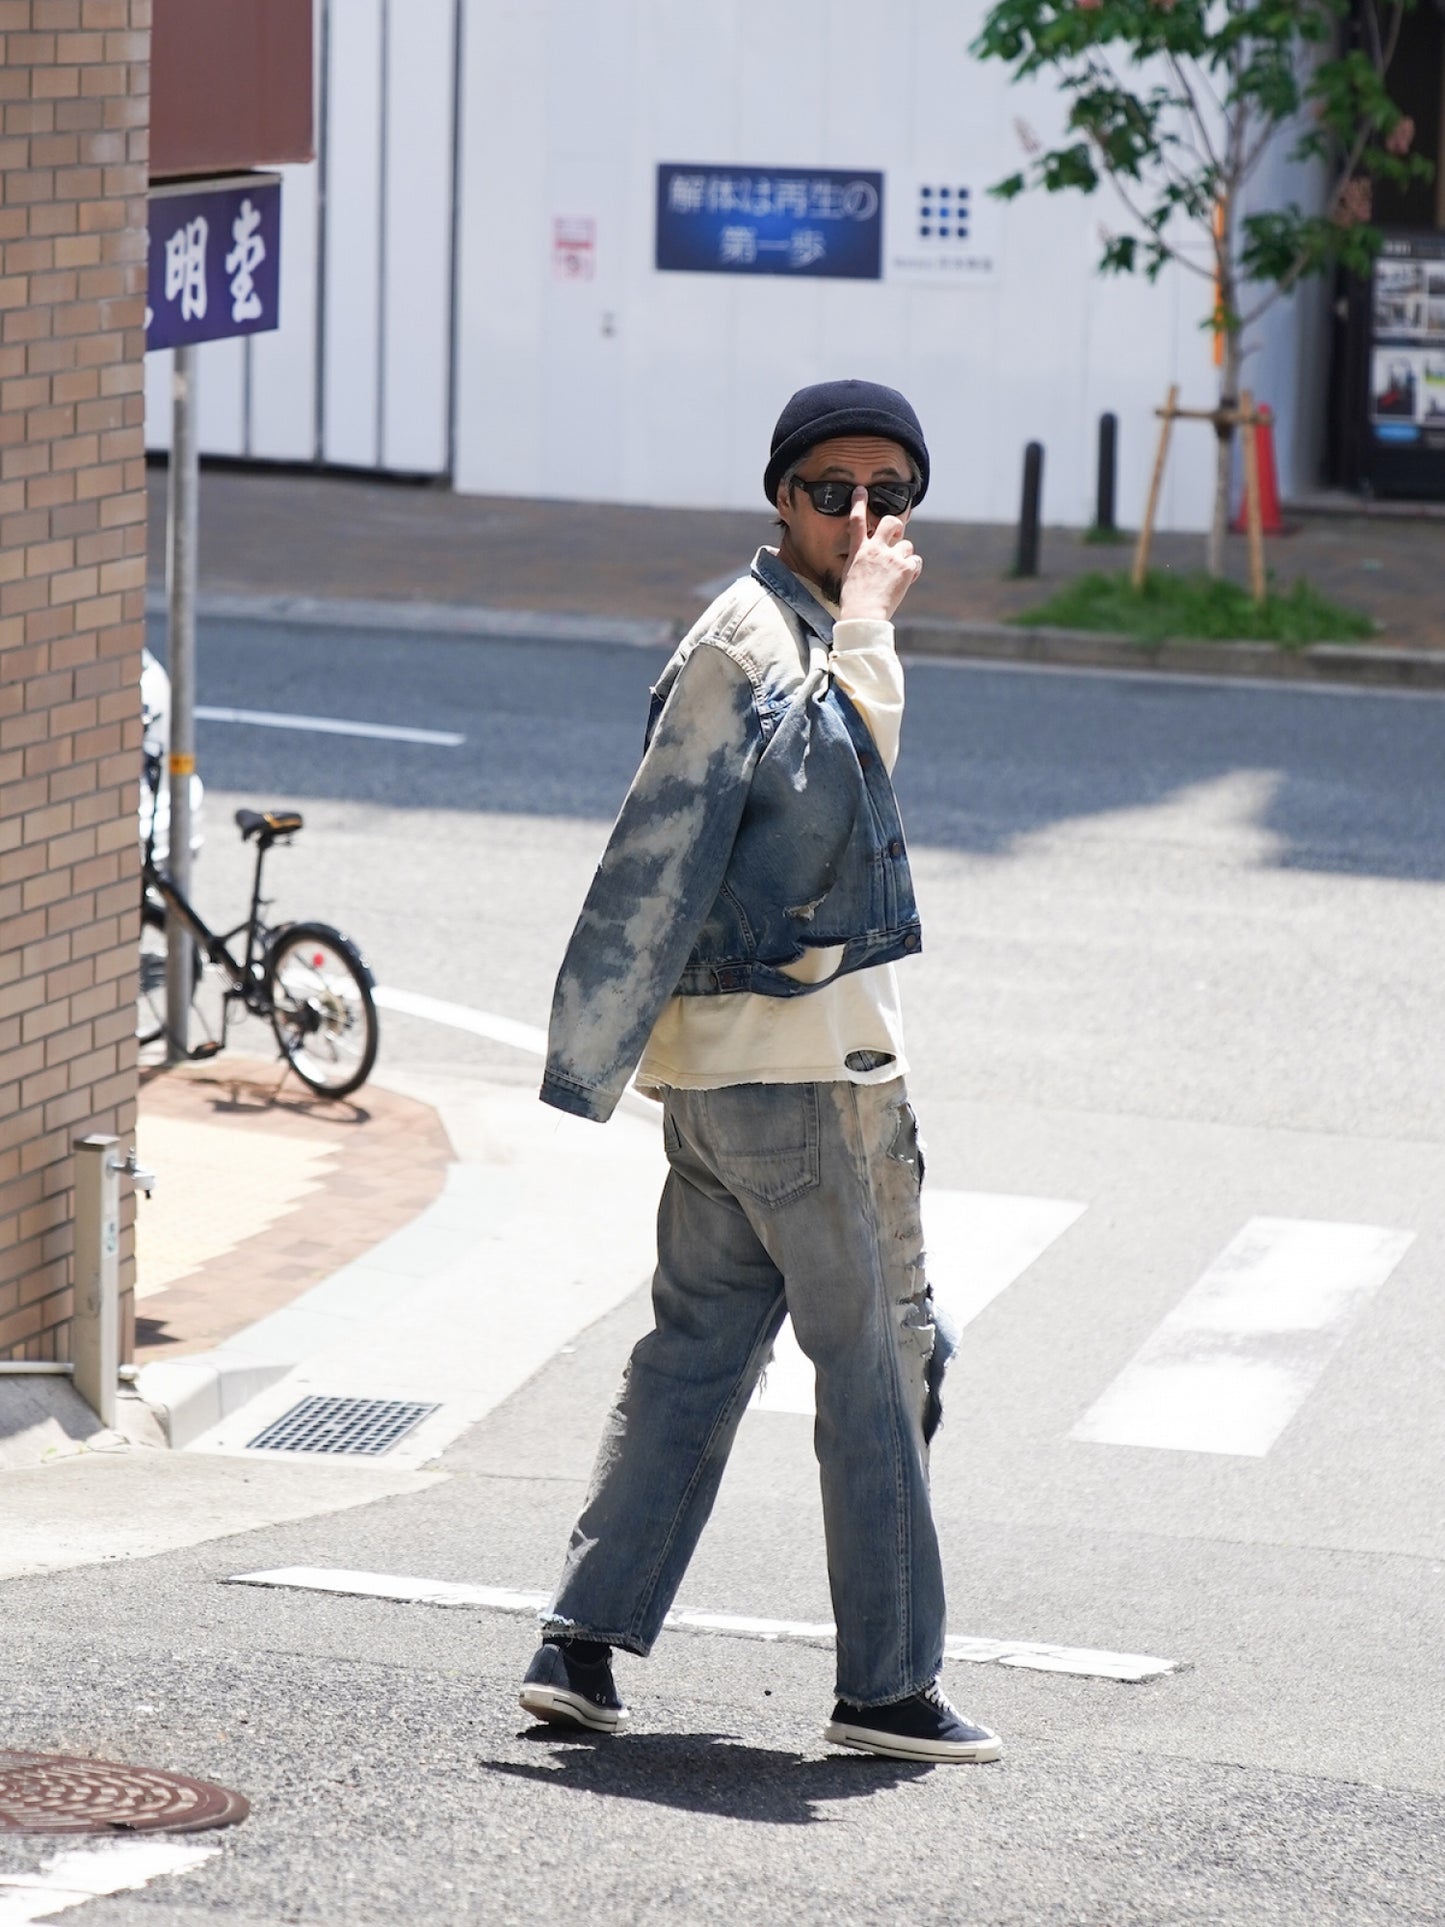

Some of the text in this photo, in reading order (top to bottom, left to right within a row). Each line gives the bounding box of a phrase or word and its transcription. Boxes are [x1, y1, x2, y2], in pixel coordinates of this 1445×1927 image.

[144, 198, 266, 330] 明堂
[720, 225, 827, 269] 第一歩
